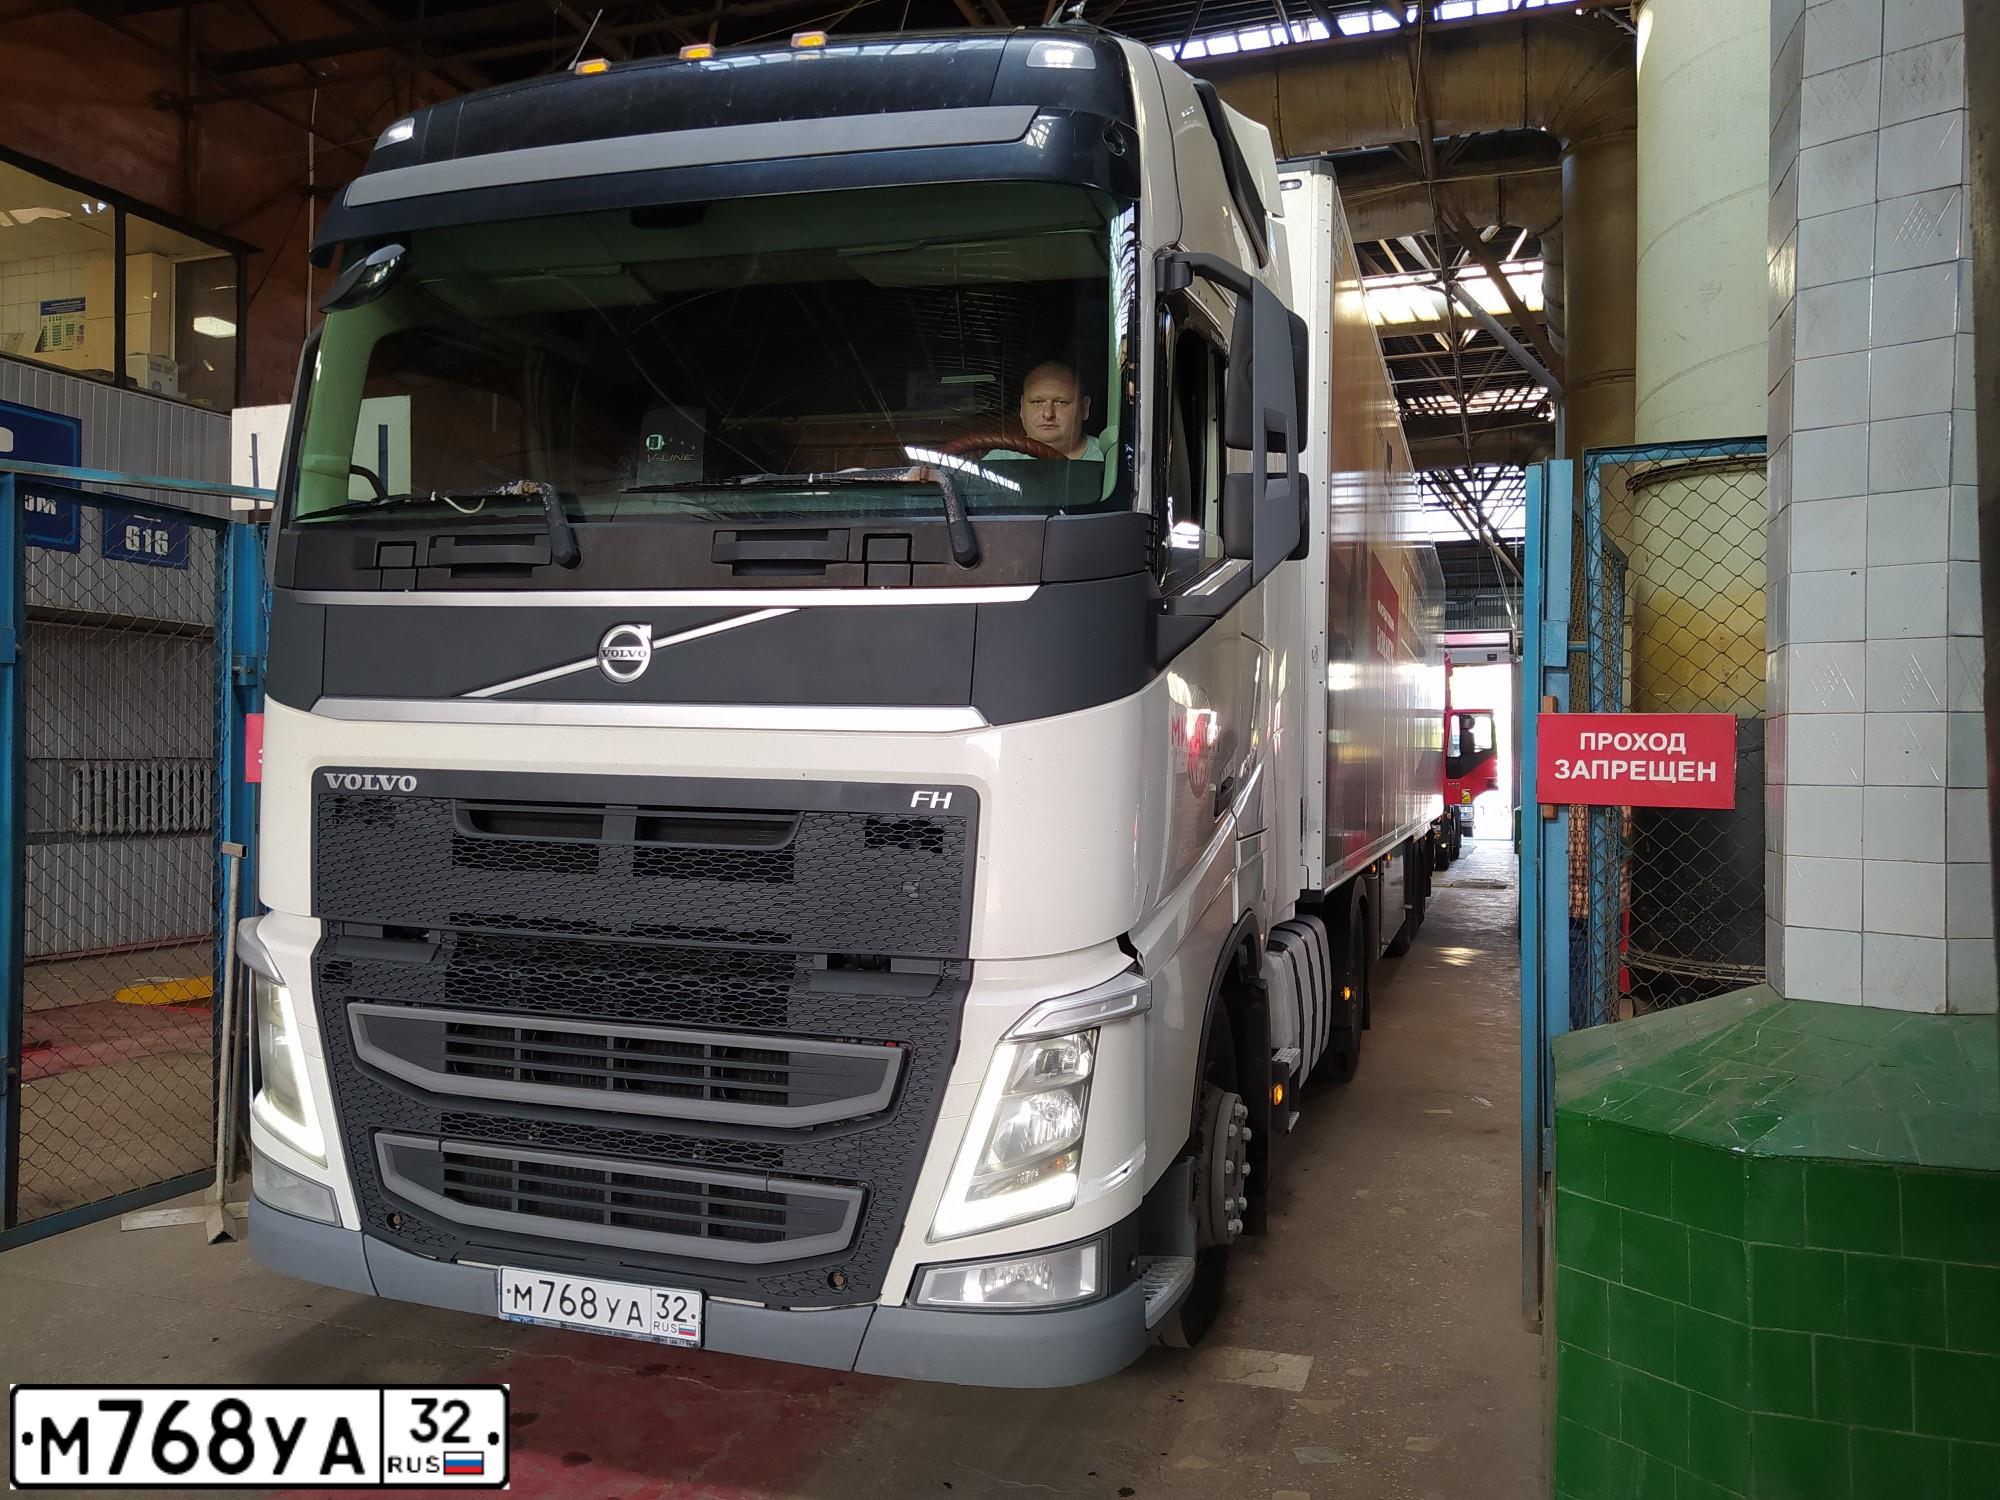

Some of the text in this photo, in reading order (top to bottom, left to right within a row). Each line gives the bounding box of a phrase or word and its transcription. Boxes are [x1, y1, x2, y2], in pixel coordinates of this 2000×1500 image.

[601, 649, 647, 658] VOLVO
[1579, 732, 1687, 755] ПРОХОД
[1554, 758, 1717, 784] ЗАПРЕЩЕН
[323, 772, 418, 792] VOLVO
[910, 790, 953, 809] FH
[656, 1293, 687, 1323] 32
[653, 1321, 677, 1334] RUS
